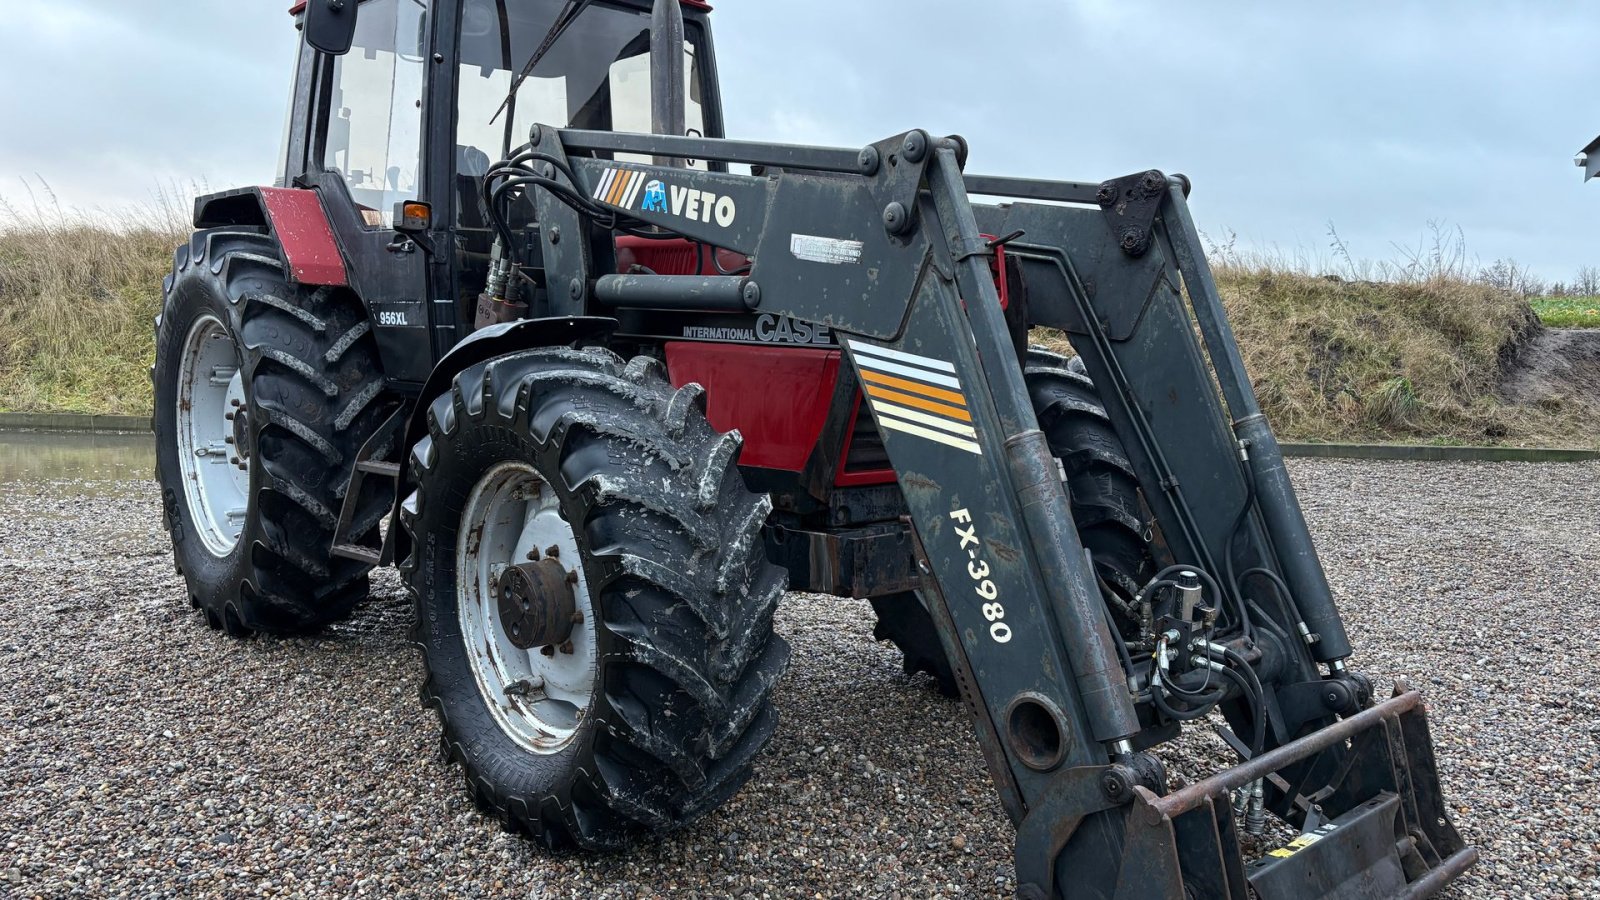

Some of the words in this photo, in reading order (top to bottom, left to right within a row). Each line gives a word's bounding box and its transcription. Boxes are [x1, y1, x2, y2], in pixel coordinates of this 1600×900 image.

[670, 185, 736, 228] VETO
[380, 311, 407, 325] 956XL
[683, 326, 755, 340] INTERNATIONAL
[756, 314, 830, 343] CASE
[949, 507, 1012, 643] FX-3980
